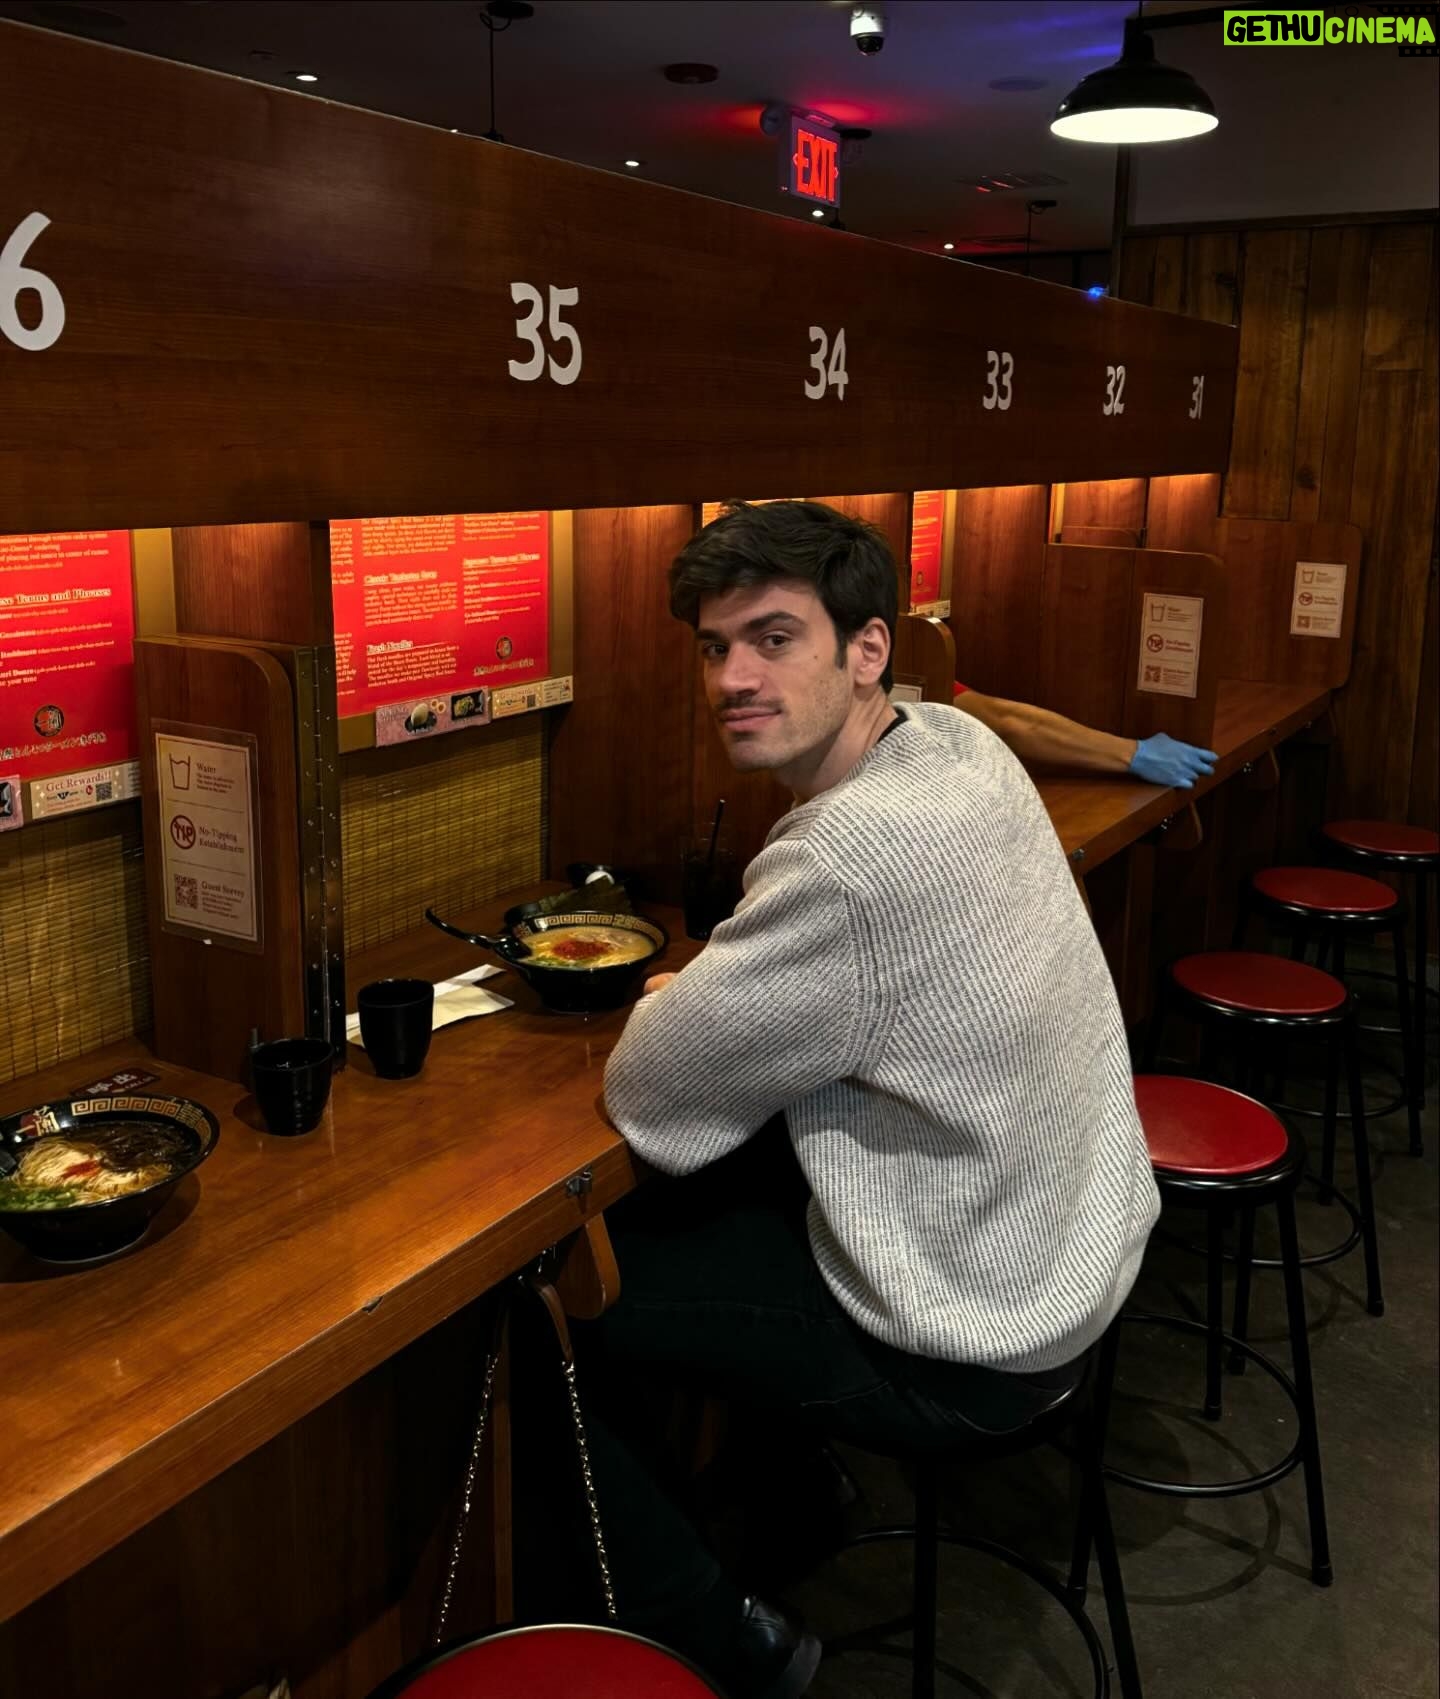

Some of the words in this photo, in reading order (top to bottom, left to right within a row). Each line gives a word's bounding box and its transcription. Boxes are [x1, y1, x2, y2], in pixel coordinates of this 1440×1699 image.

[797, 128, 838, 202] EXIT
[508, 282, 582, 386] 35
[804, 326, 849, 401] 34
[983, 350, 1014, 410] 33
[1103, 365, 1126, 416] 32
[1189, 374, 1204, 419] 31
[46, 781, 64, 792] Get
[196, 762, 216, 774] Water
